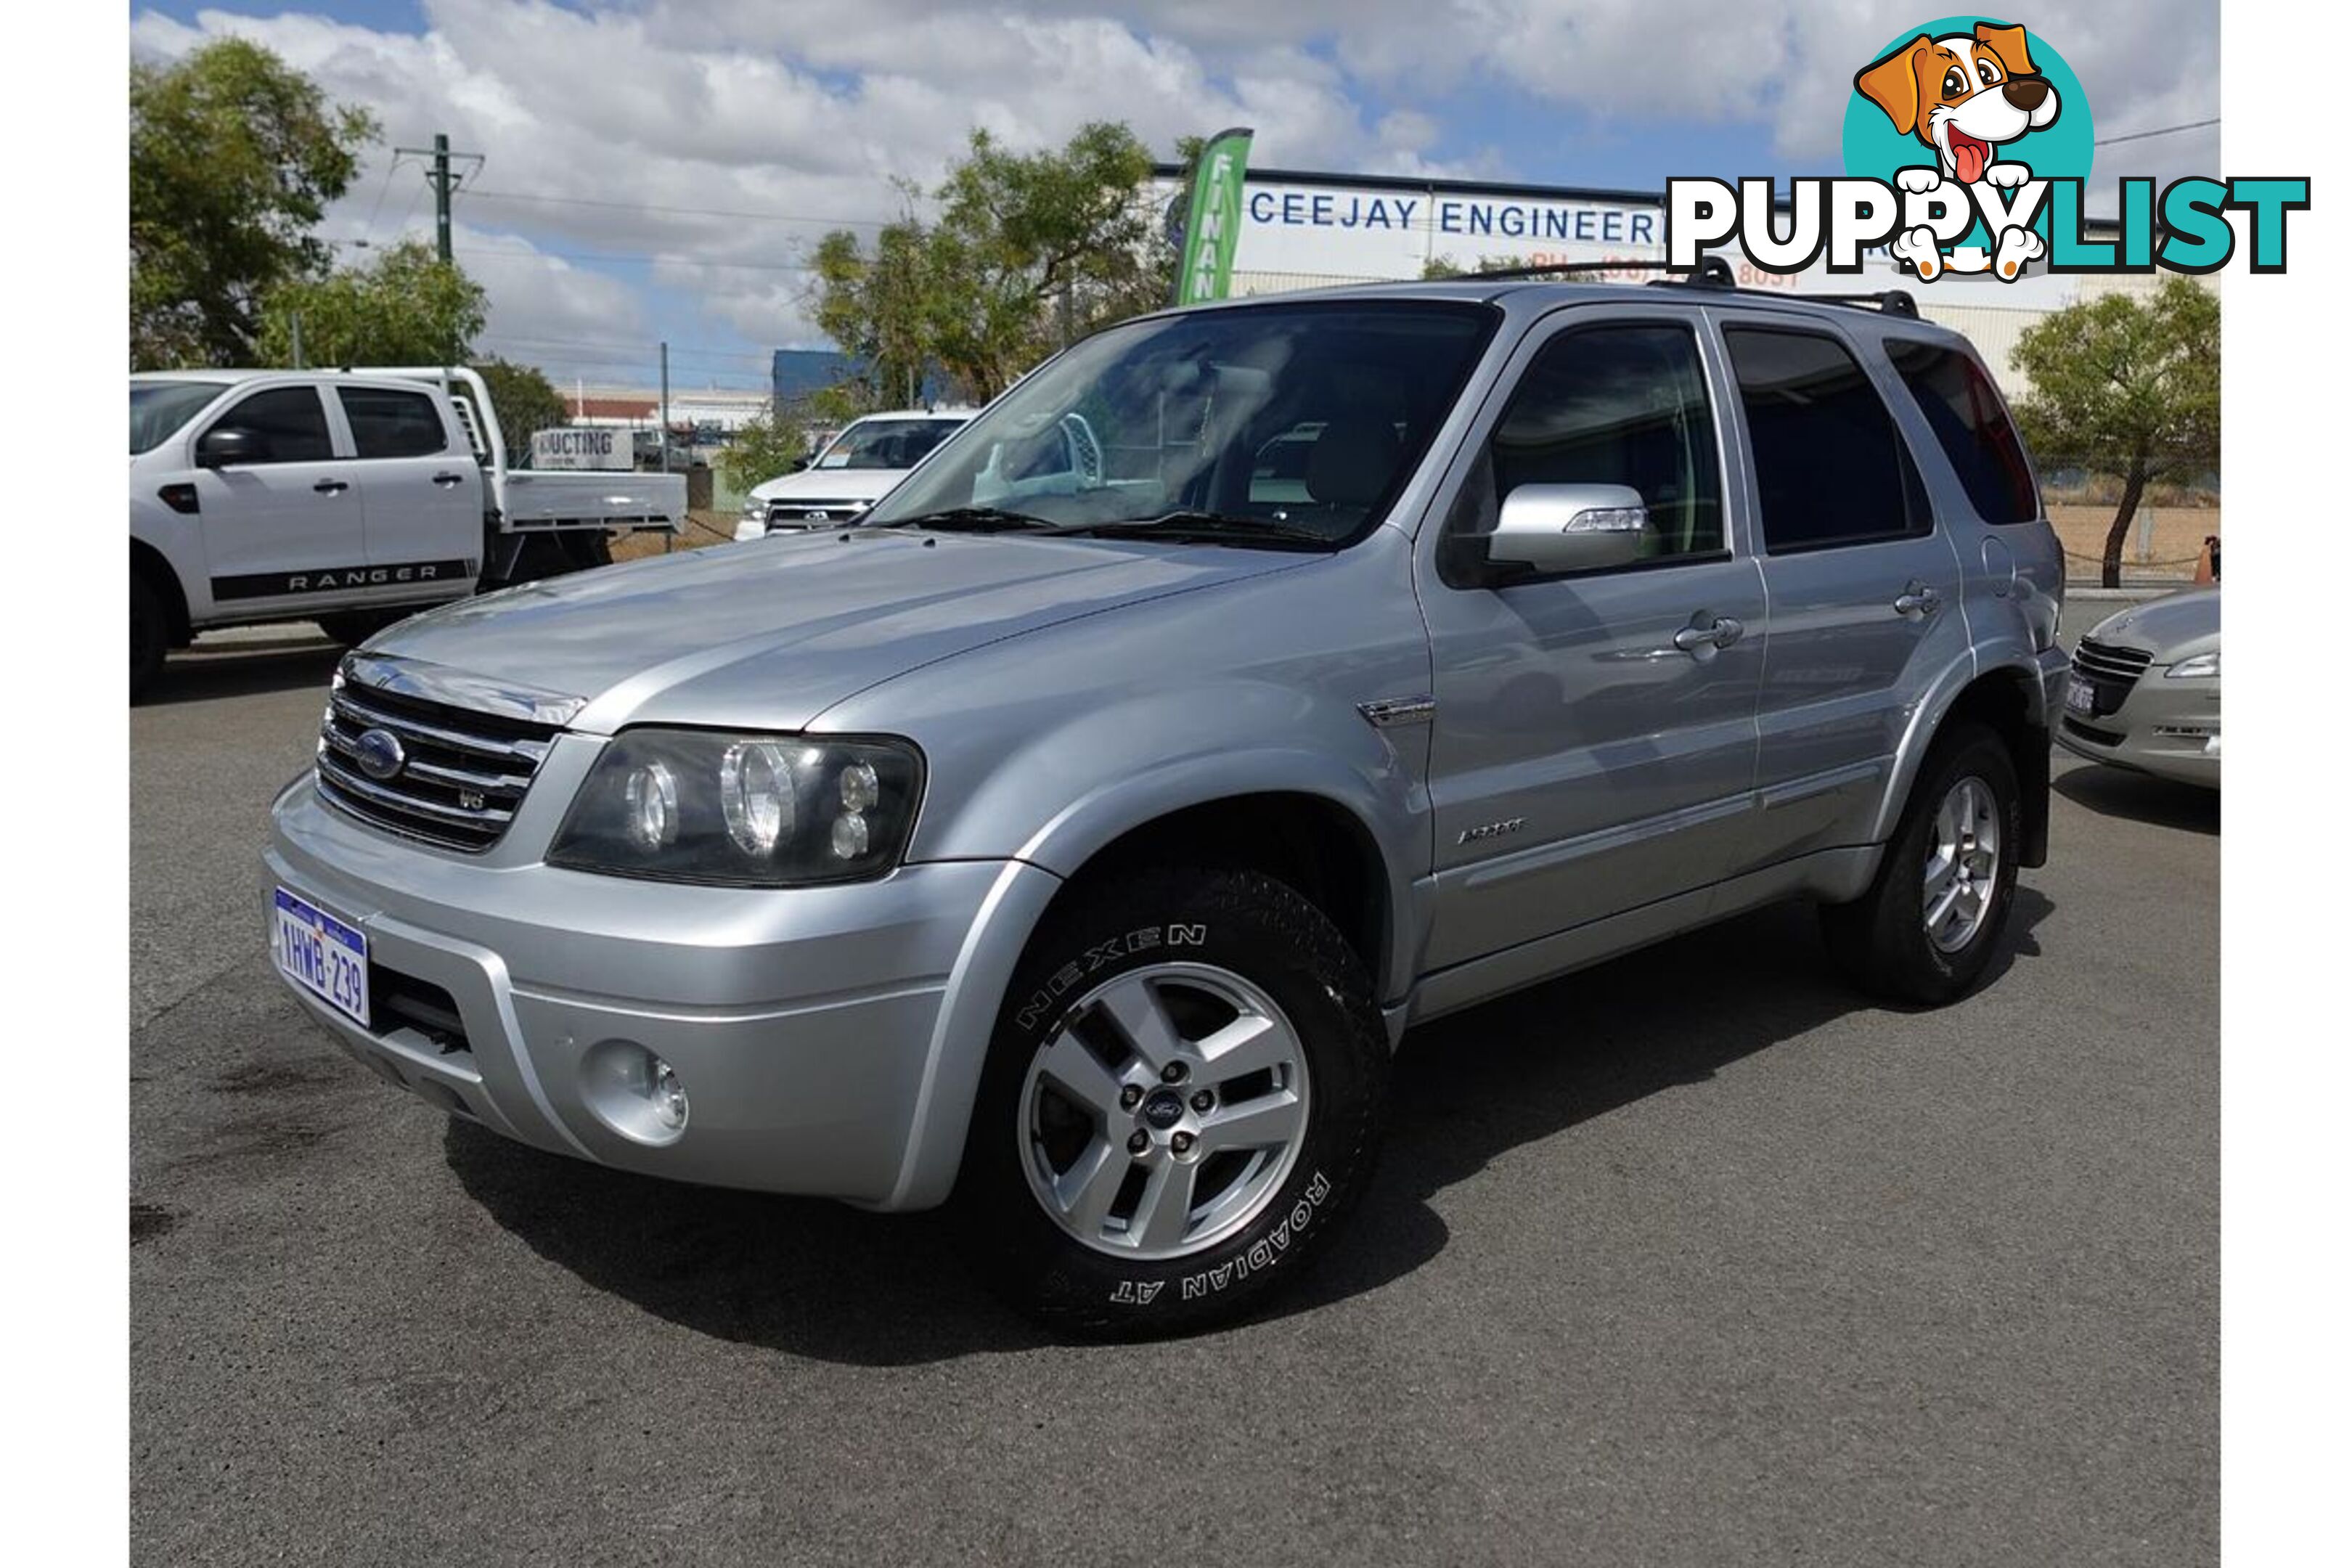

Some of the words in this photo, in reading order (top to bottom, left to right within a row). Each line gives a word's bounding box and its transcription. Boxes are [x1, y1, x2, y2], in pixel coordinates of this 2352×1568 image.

[1251, 192, 1416, 229] CEEJAY
[288, 565, 436, 590] RANGER
[1016, 924, 1206, 1029] NEXEN
[1183, 1171, 1331, 1300] ROADIAN
[1109, 1281, 1165, 1304] AT
